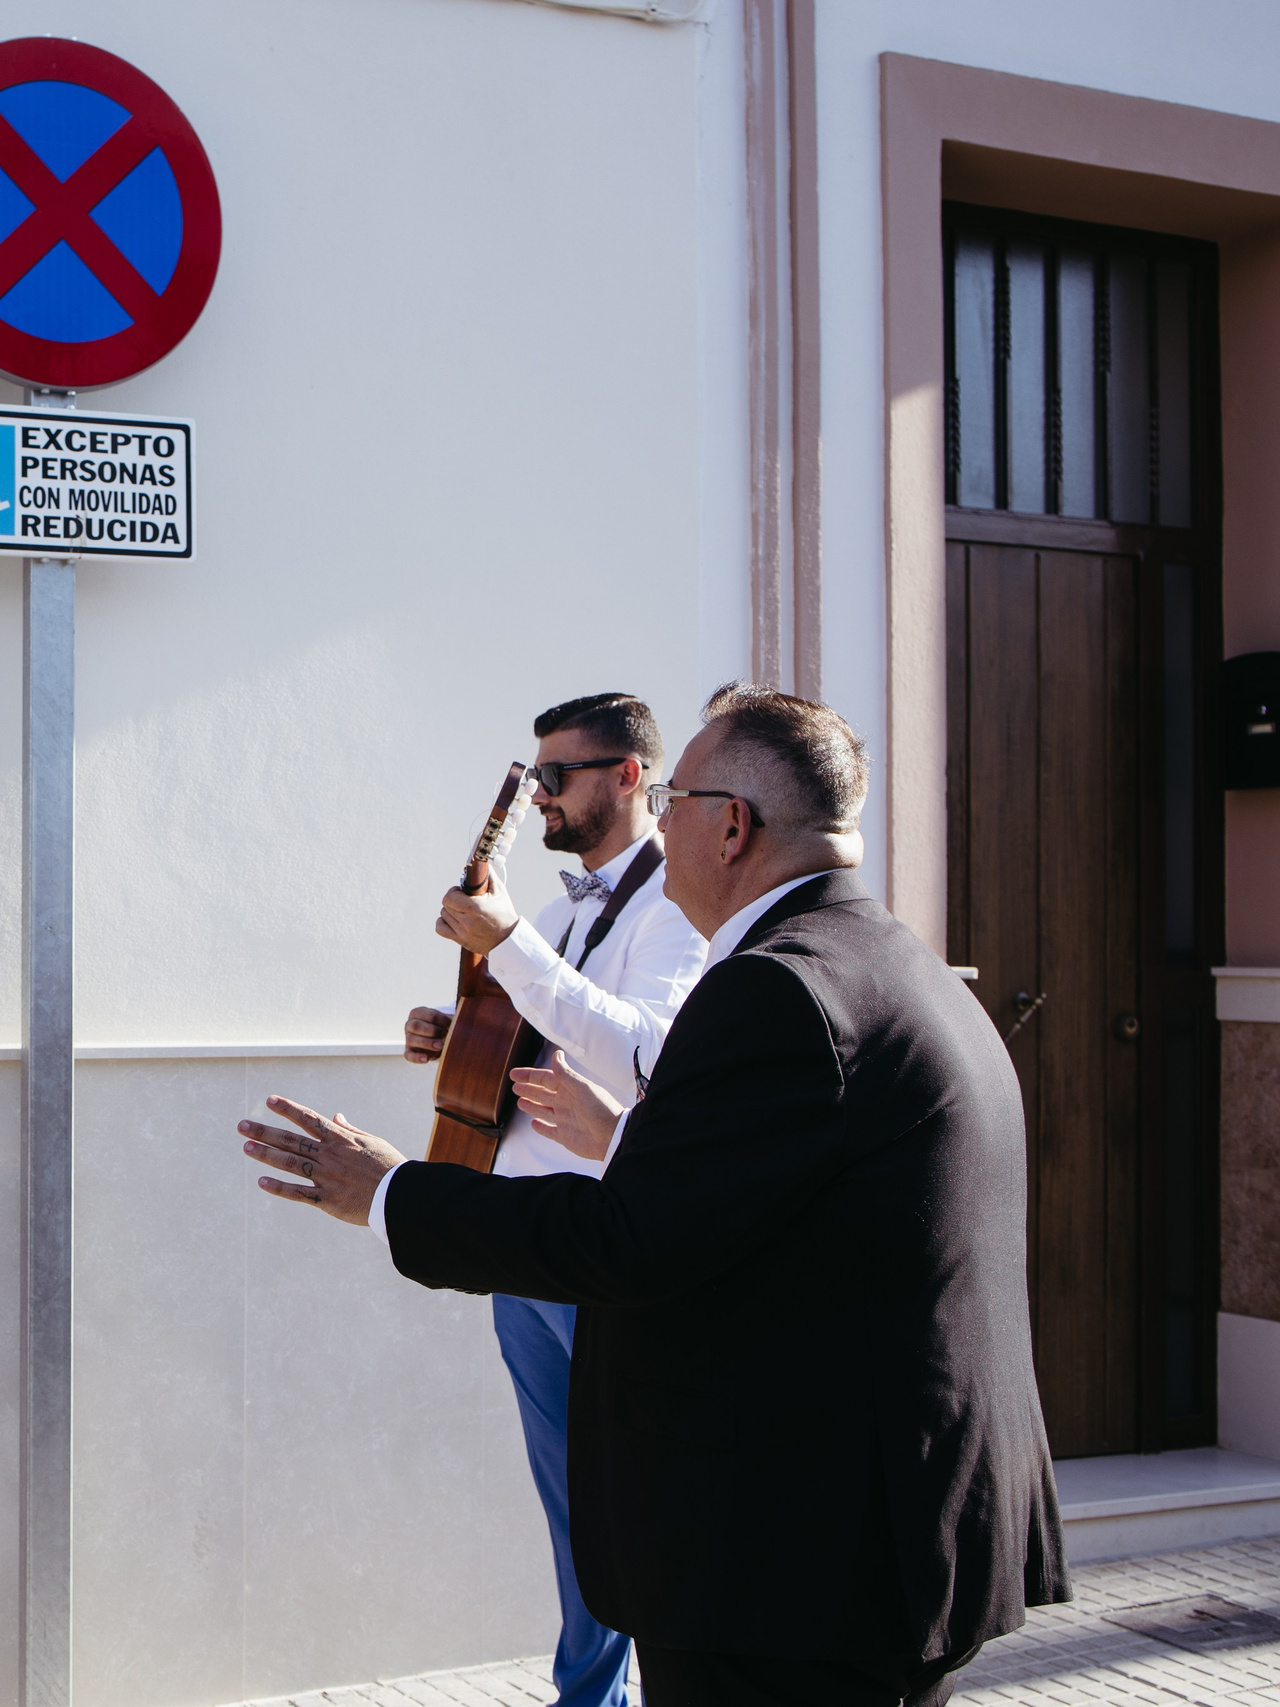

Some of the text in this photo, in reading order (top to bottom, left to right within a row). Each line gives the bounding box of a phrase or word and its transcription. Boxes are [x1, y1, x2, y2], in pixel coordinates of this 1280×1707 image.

[21, 426, 175, 458] EXCEPTO
[21, 455, 176, 487] PERSONAS
[19, 485, 177, 516] CON MOVILIDAD
[21, 514, 181, 545] REDUCIDA
